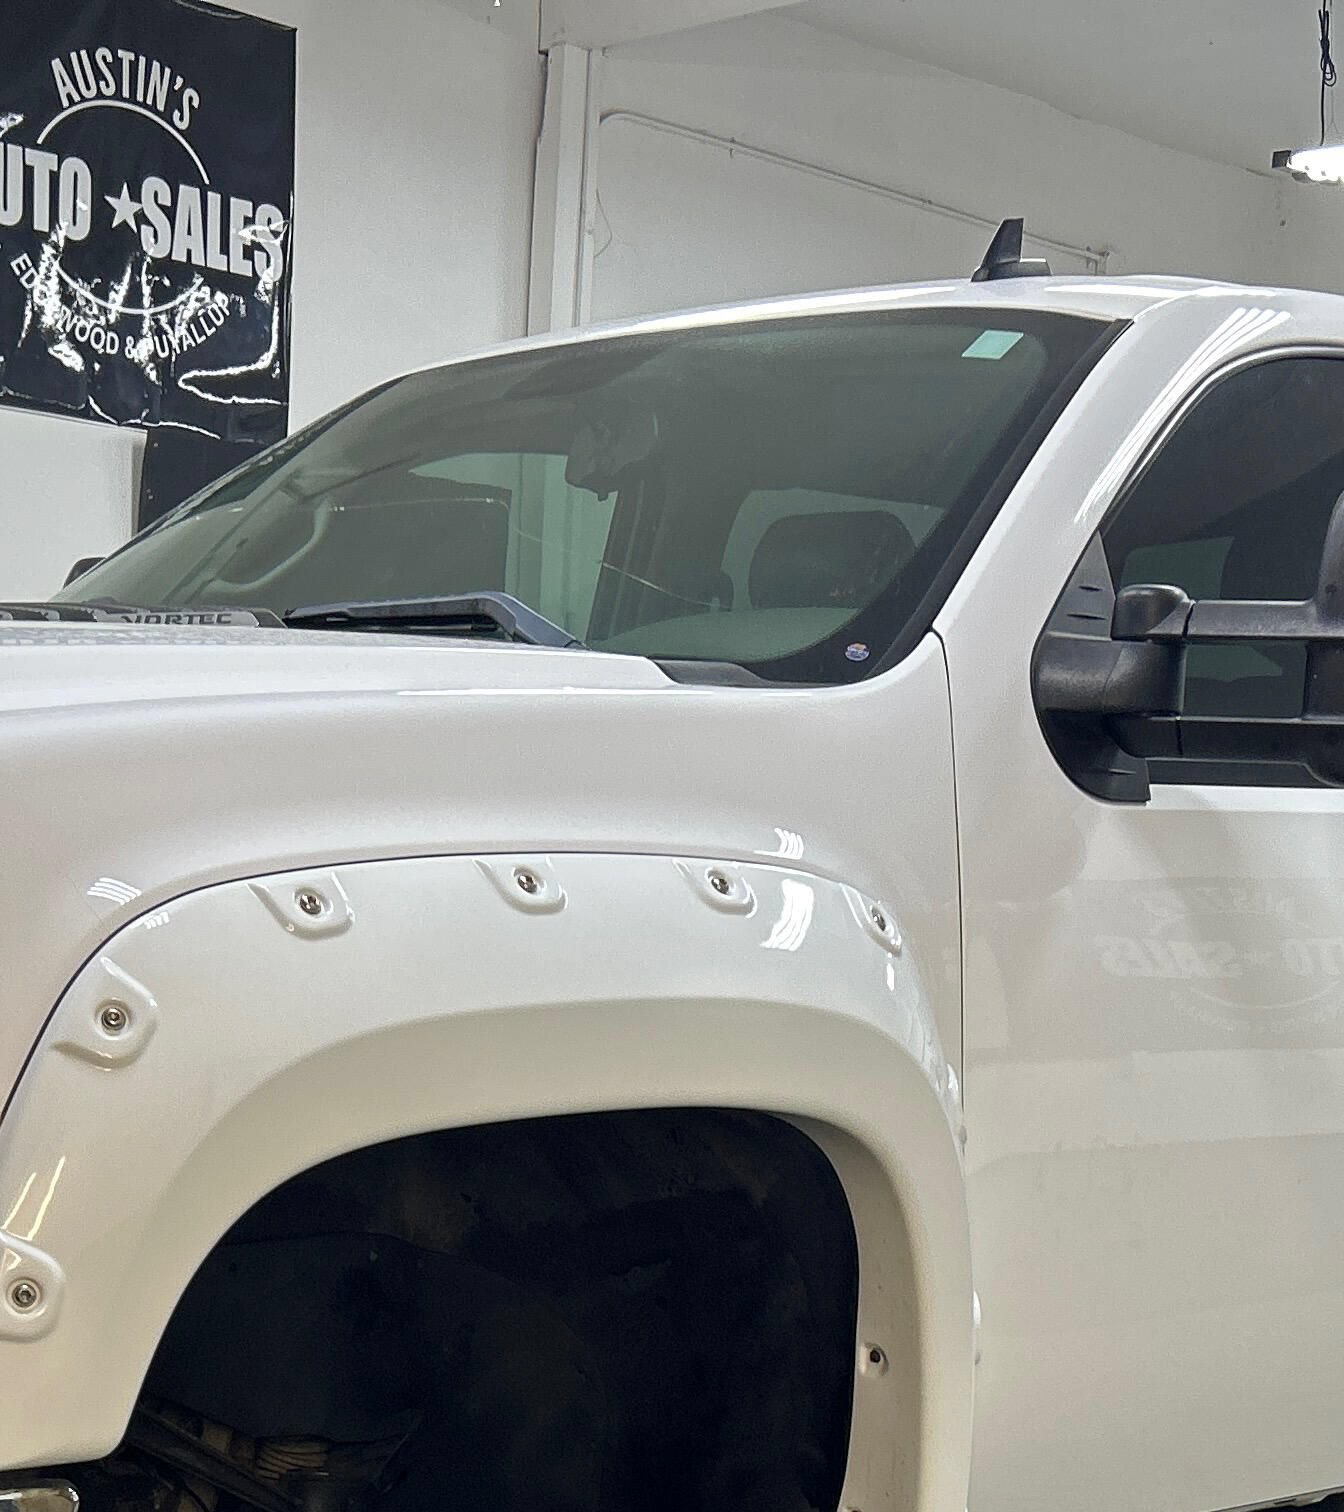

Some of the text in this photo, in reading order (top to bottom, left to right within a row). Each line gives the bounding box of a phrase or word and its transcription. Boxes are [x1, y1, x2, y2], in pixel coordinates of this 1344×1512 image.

[51, 47, 199, 130] AUSTIN'S
[140, 177, 284, 282] SALES
[11, 253, 119, 355] EDWOOD
[140, 292, 232, 358] UYALLUP
[121, 612, 232, 625] VORTEC
